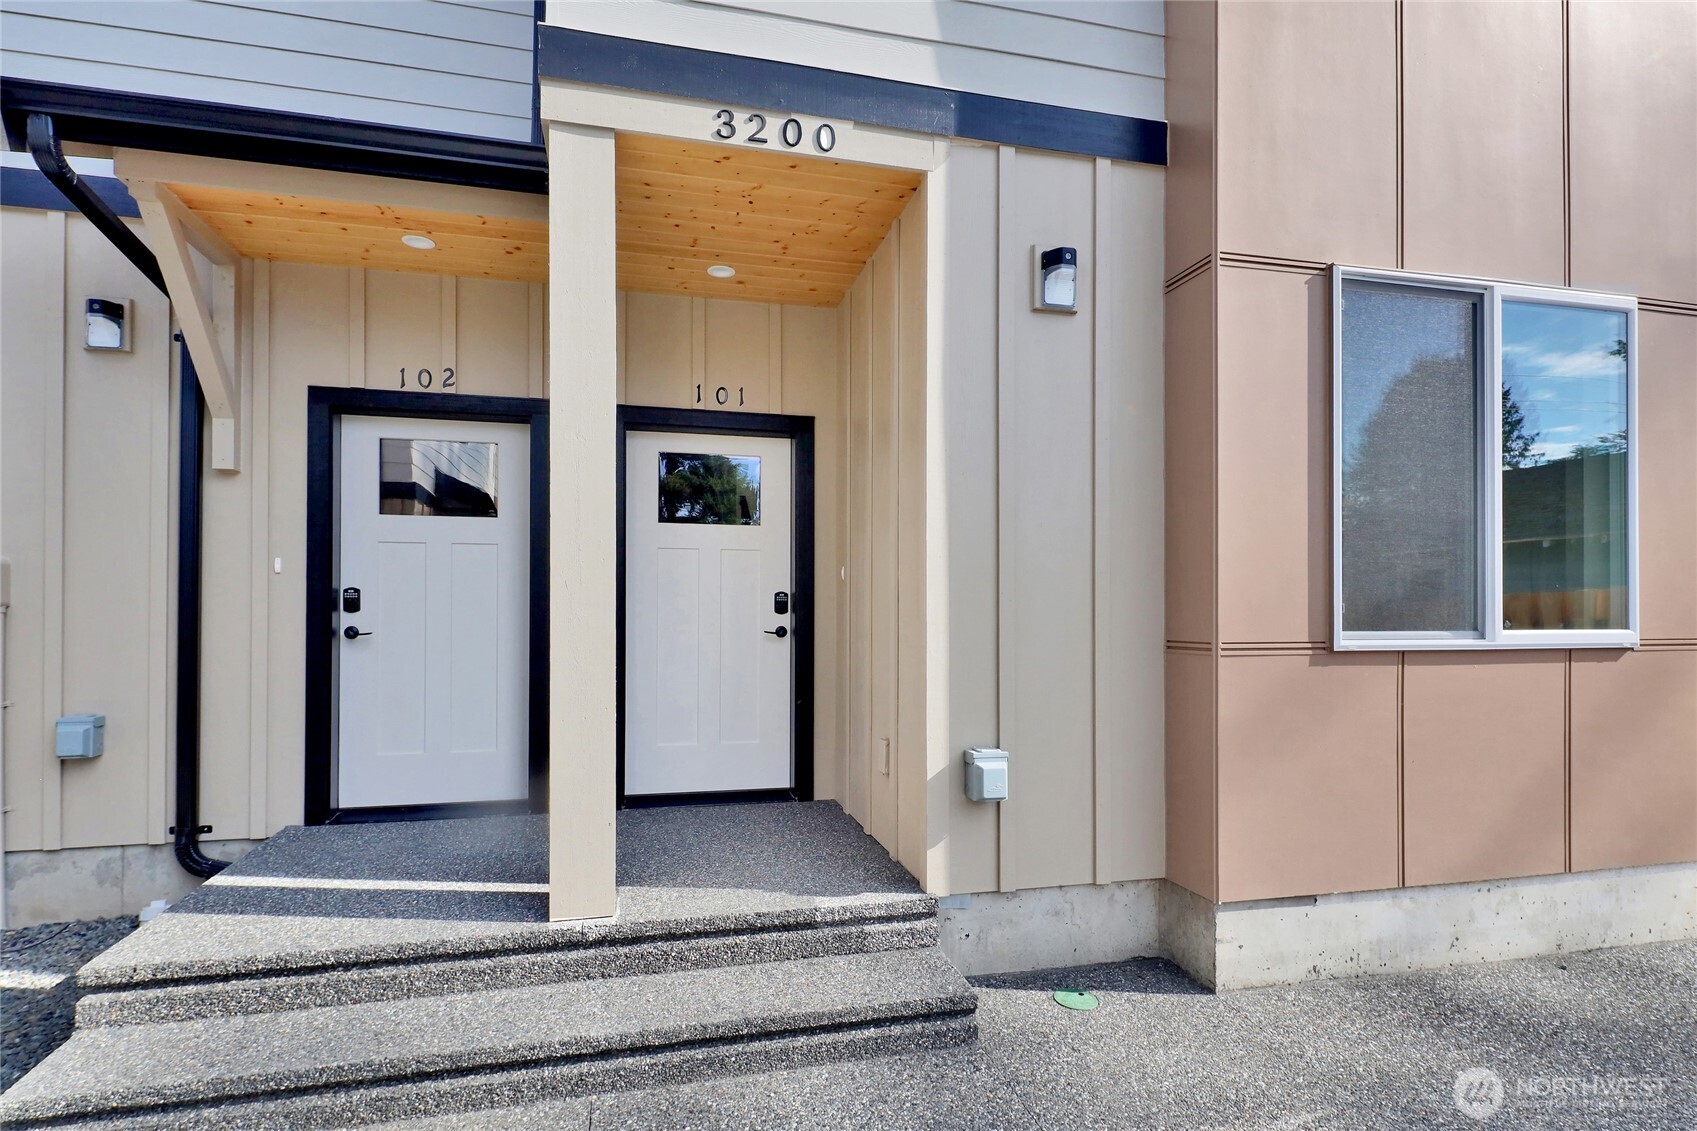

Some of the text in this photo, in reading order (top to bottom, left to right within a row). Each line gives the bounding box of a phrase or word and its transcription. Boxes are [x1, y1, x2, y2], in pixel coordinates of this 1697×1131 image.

[716, 109, 836, 152] 3200
[399, 367, 456, 389] 102
[696, 383, 745, 407] 101
